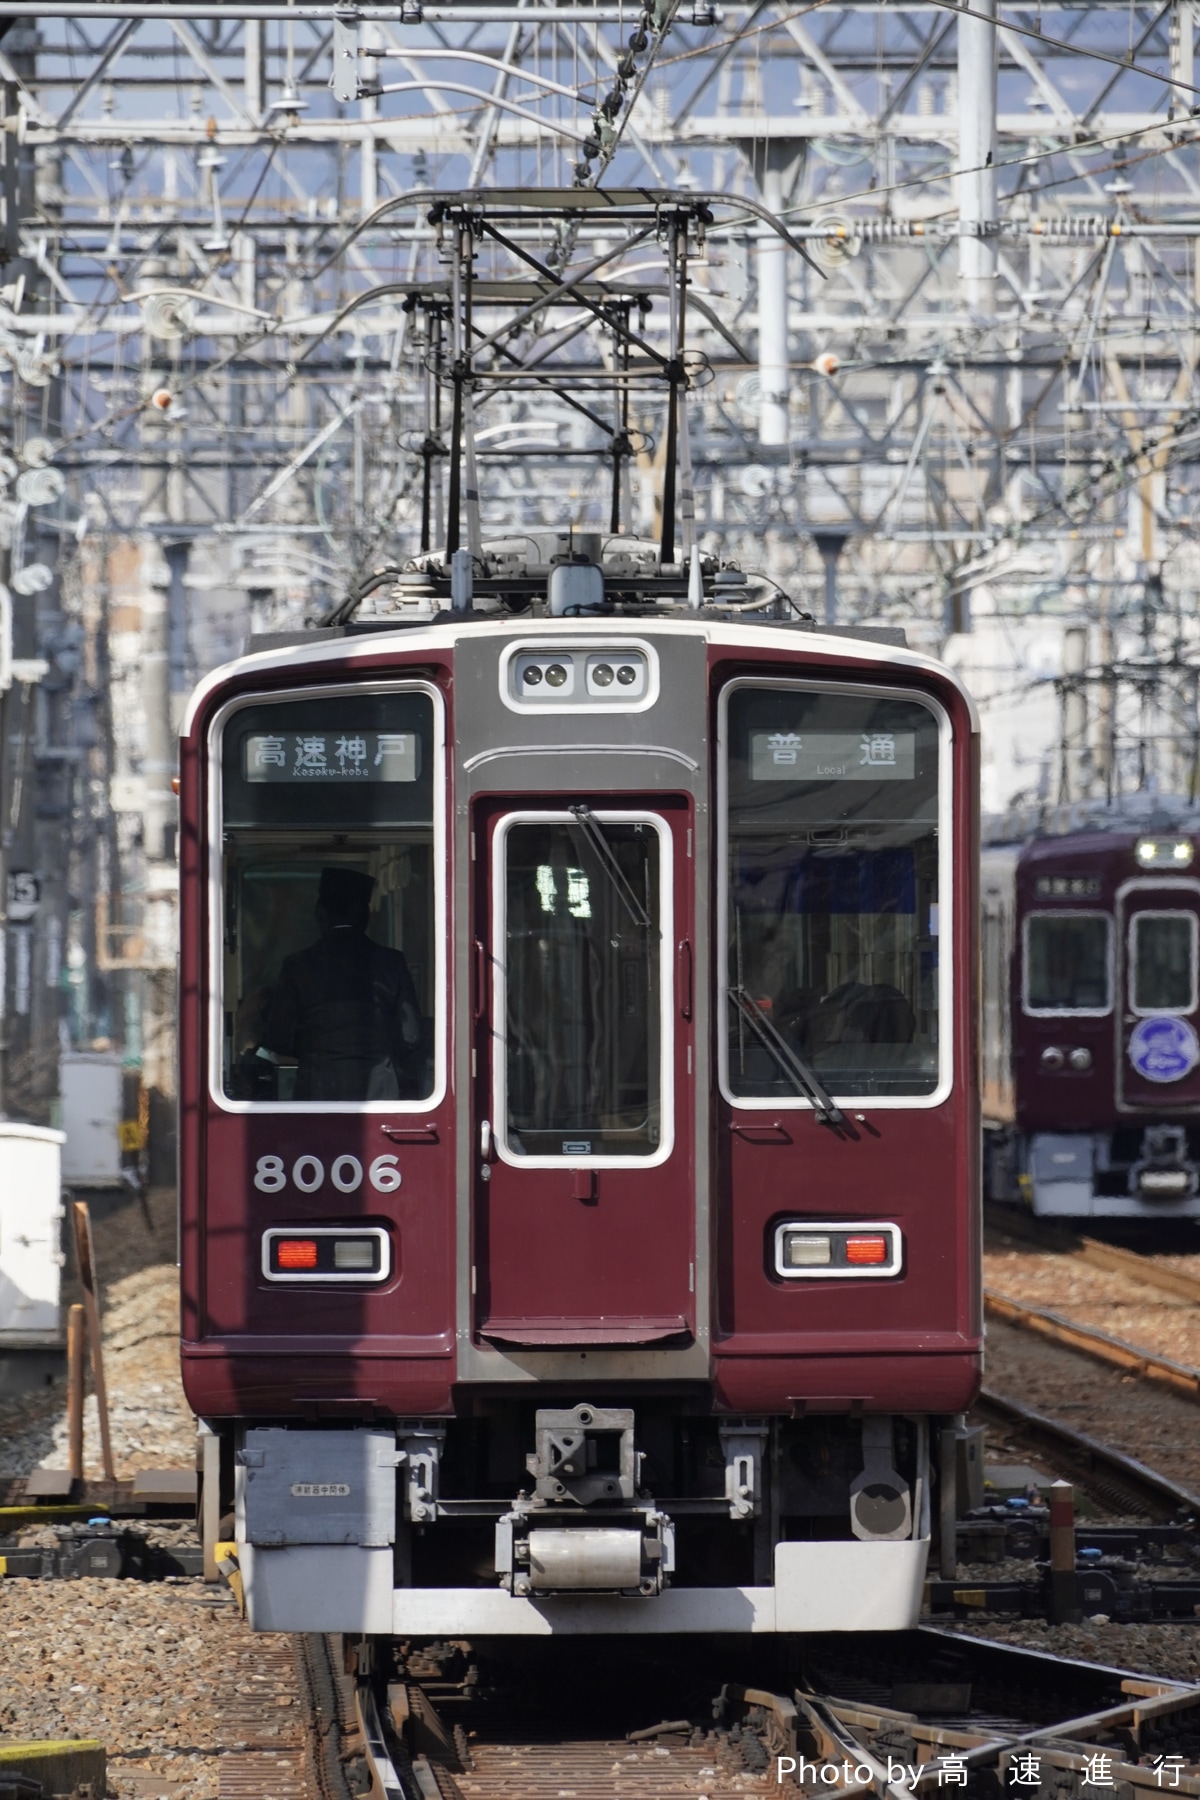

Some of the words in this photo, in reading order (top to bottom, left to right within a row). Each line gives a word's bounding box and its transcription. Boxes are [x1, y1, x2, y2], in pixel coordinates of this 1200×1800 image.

[254, 734, 407, 766] 高速神戸
[767, 732, 897, 766] 普通
[816, 765, 846, 776] Local
[253, 1154, 402, 1194] 8006
